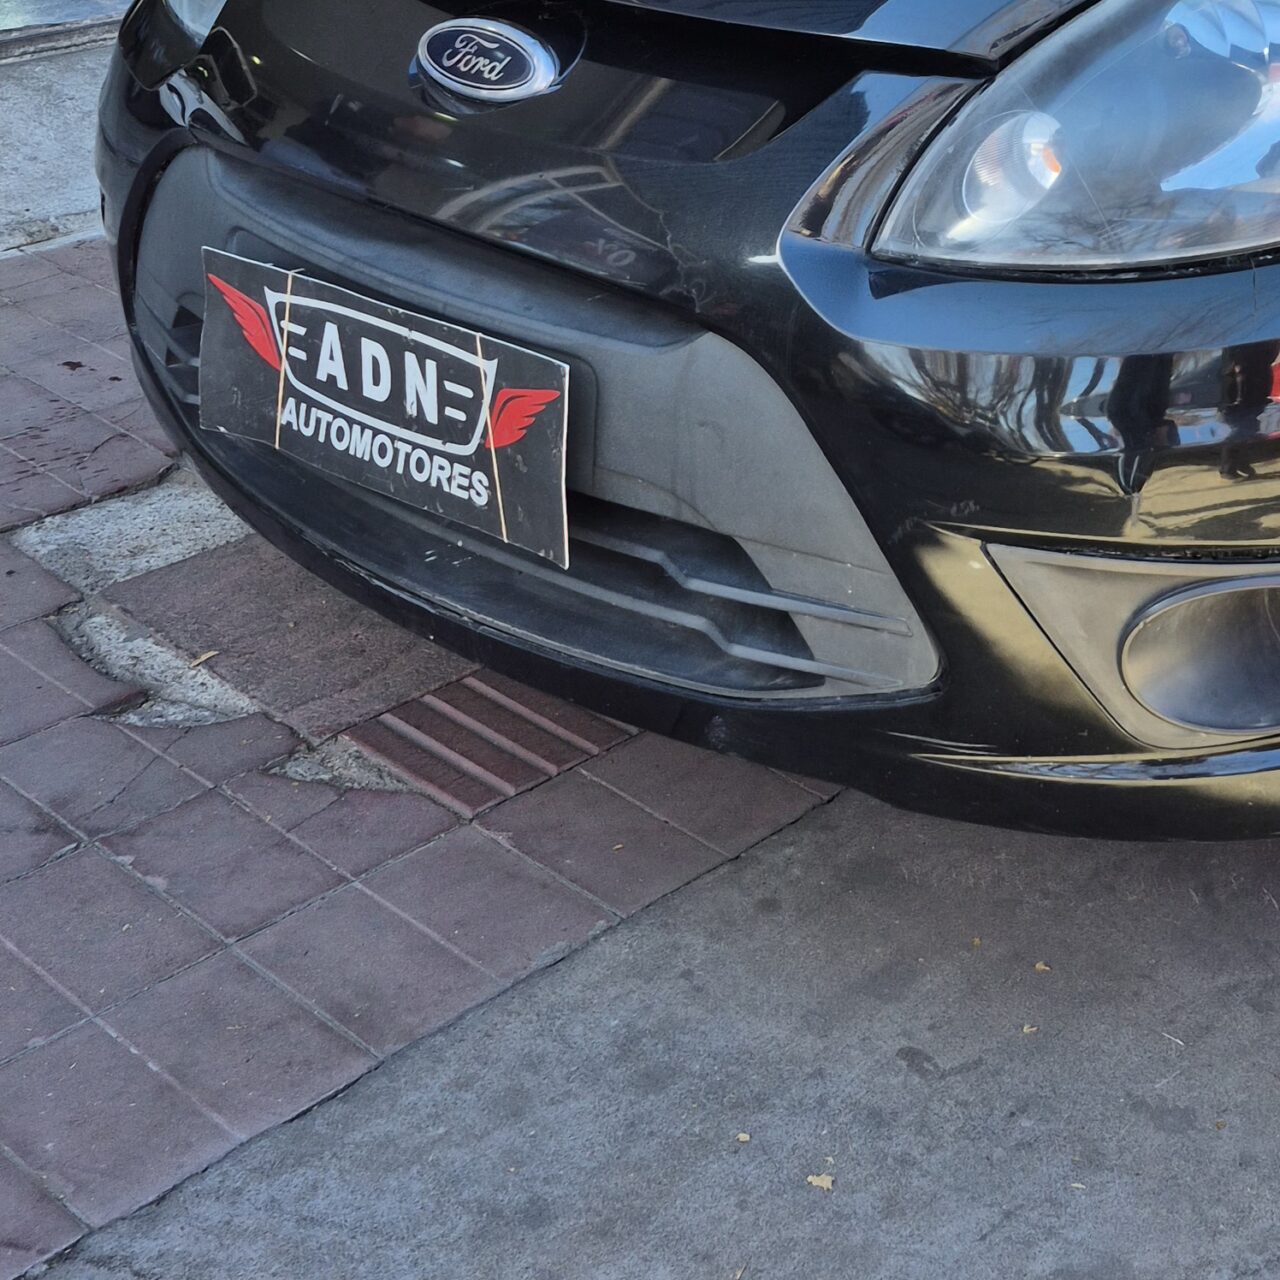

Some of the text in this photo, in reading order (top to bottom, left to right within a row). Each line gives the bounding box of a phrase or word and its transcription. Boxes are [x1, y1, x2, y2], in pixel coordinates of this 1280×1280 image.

[441, 33, 512, 81] Ford
[315, 320, 438, 425] ADN
[281, 397, 490, 507] AUTOMOTORES
